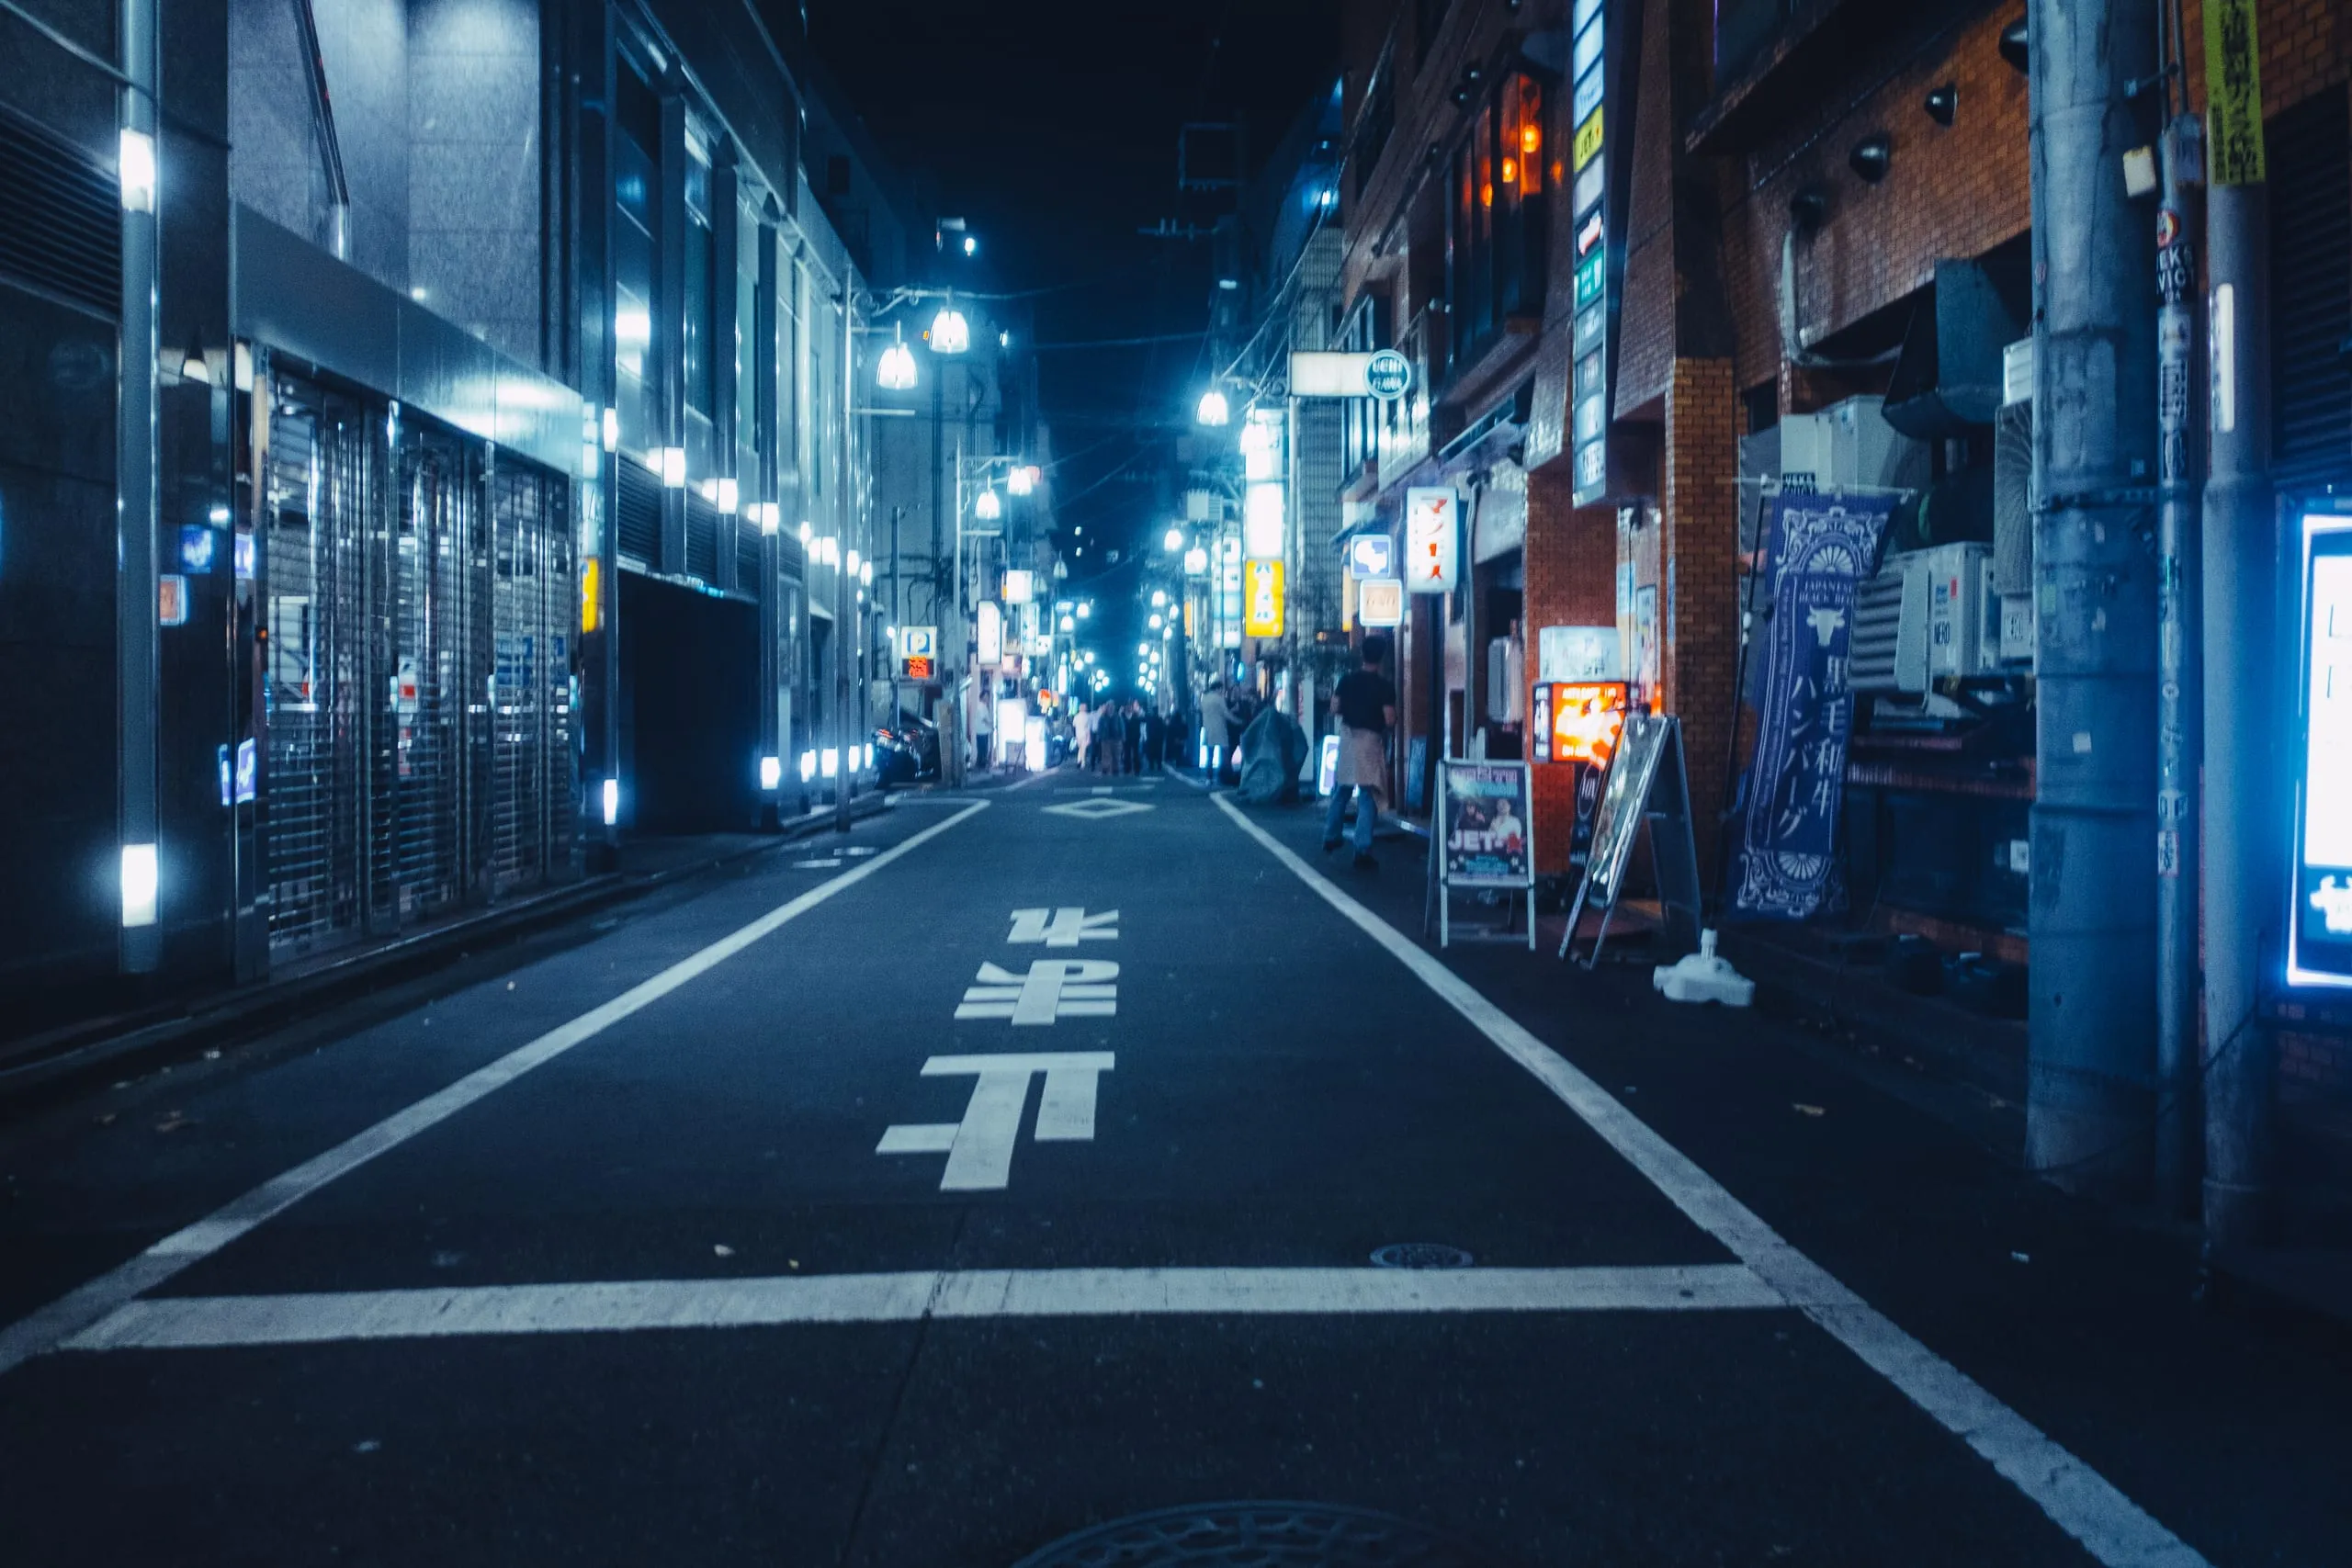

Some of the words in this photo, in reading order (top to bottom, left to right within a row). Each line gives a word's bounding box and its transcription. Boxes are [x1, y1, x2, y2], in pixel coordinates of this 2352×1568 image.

[1372, 357, 1404, 373] UCHI
[1798, 592, 1830, 604] BLACK
[1804, 580, 1852, 594] JAPANESE
[910, 630, 928, 653] P
[1812, 654, 1848, 819] 黒毛和牛
[1778, 673, 1818, 840] ハンバーグ
[876, 907, 1120, 1191] 止まれ
